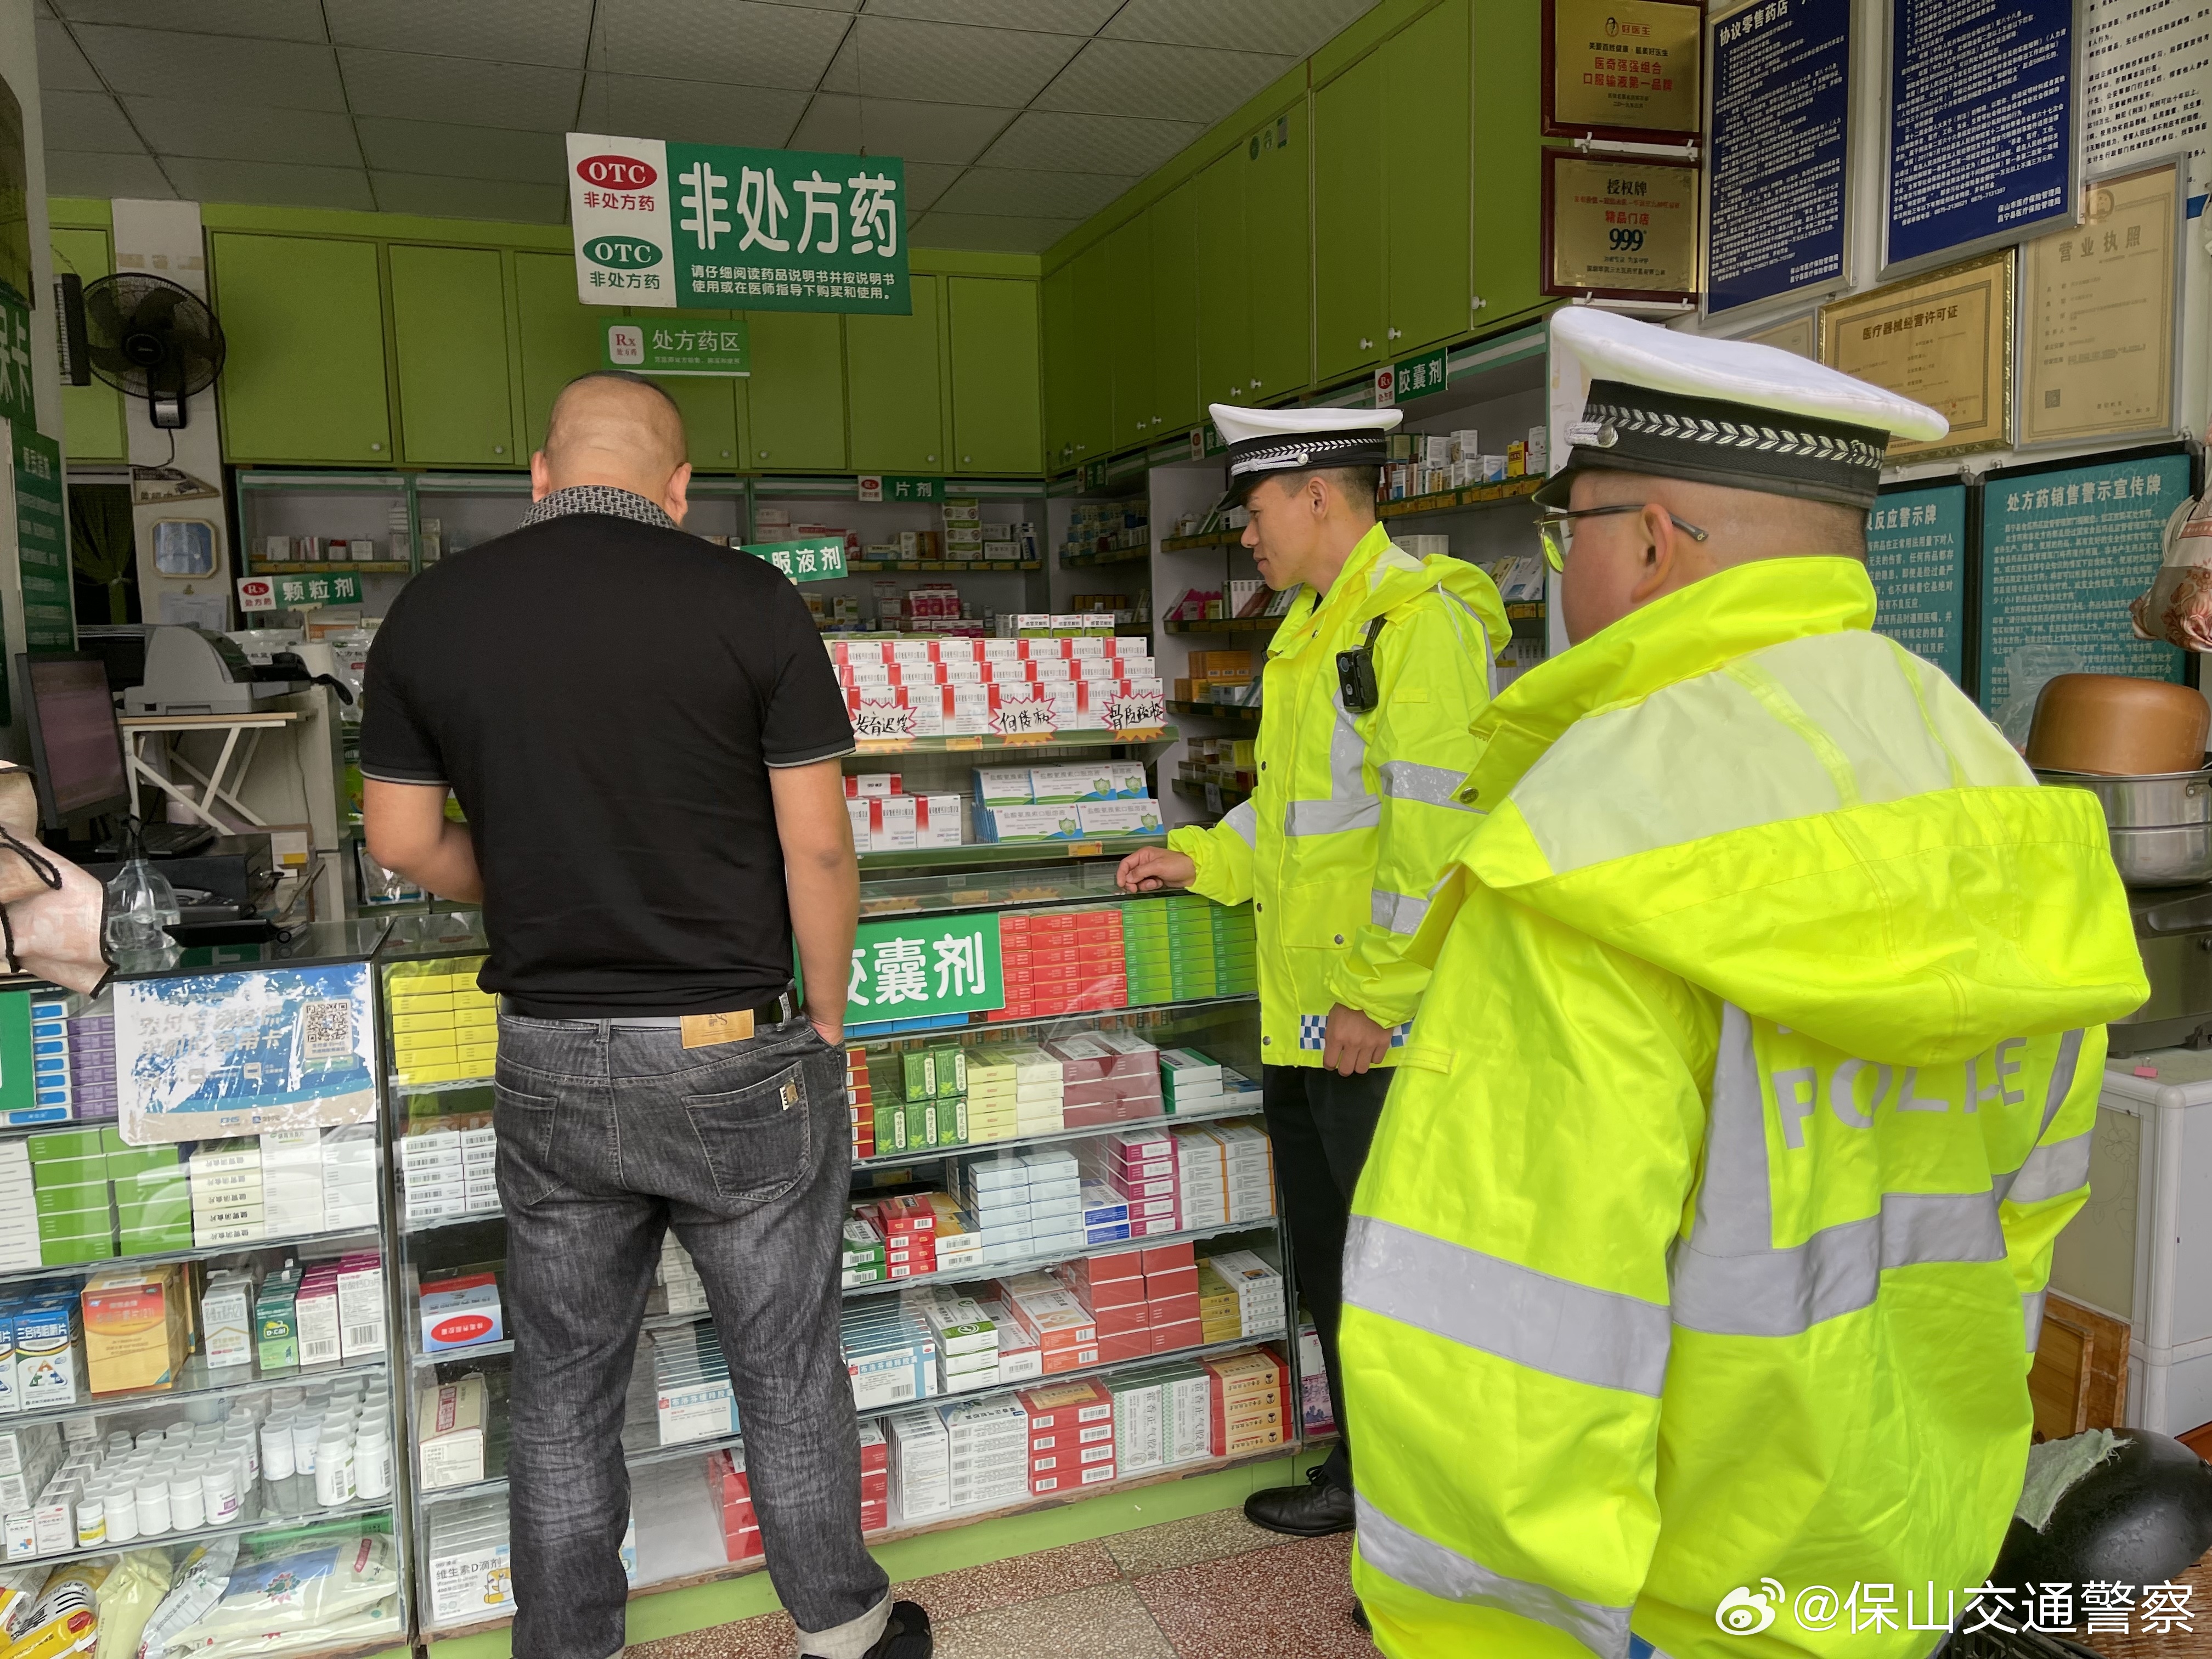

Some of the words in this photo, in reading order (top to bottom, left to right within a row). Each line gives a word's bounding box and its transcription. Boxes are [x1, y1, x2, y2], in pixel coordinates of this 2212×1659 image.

[1622, 24, 1650, 35] 好医生
[1595, 57, 1661, 75] 医奇强强组合
[1583, 74, 1673, 92] 口服输液第一品牌
[589, 162, 647, 184] OTC
[1607, 179, 1647, 196] 授权牌
[584, 191, 655, 211] 非处方药
[679, 162, 897, 257] 非处方药
[1606, 210, 1650, 225] 精品门店
[1610, 228, 1644, 251] 999
[2059, 225, 2141, 263] 营业执照
[595, 241, 652, 263] OTC
[590, 270, 660, 290] 非处方药
[692, 264, 895, 285] 请仔细阅读药品说明书并按说明书
[692, 280, 890, 300] 使用或在医师指导下购买和使用。
[1863, 305, 1958, 340] 医疗器械经营许可证
[615, 334, 636, 346] Rx
[652, 330, 741, 352] 处方药区
[617, 348, 637, 356] 处方药
[1399, 358, 1442, 394] 胶囊剂
[896, 482, 932, 496] 片剂
[2007, 473, 2160, 512] 处方药销售警示宣传牌
[756, 545, 842, 574] 服液剂
[283, 577, 354, 602] 颗粒剂
[436, 1557, 501, 1579] 维生素D滴剂
